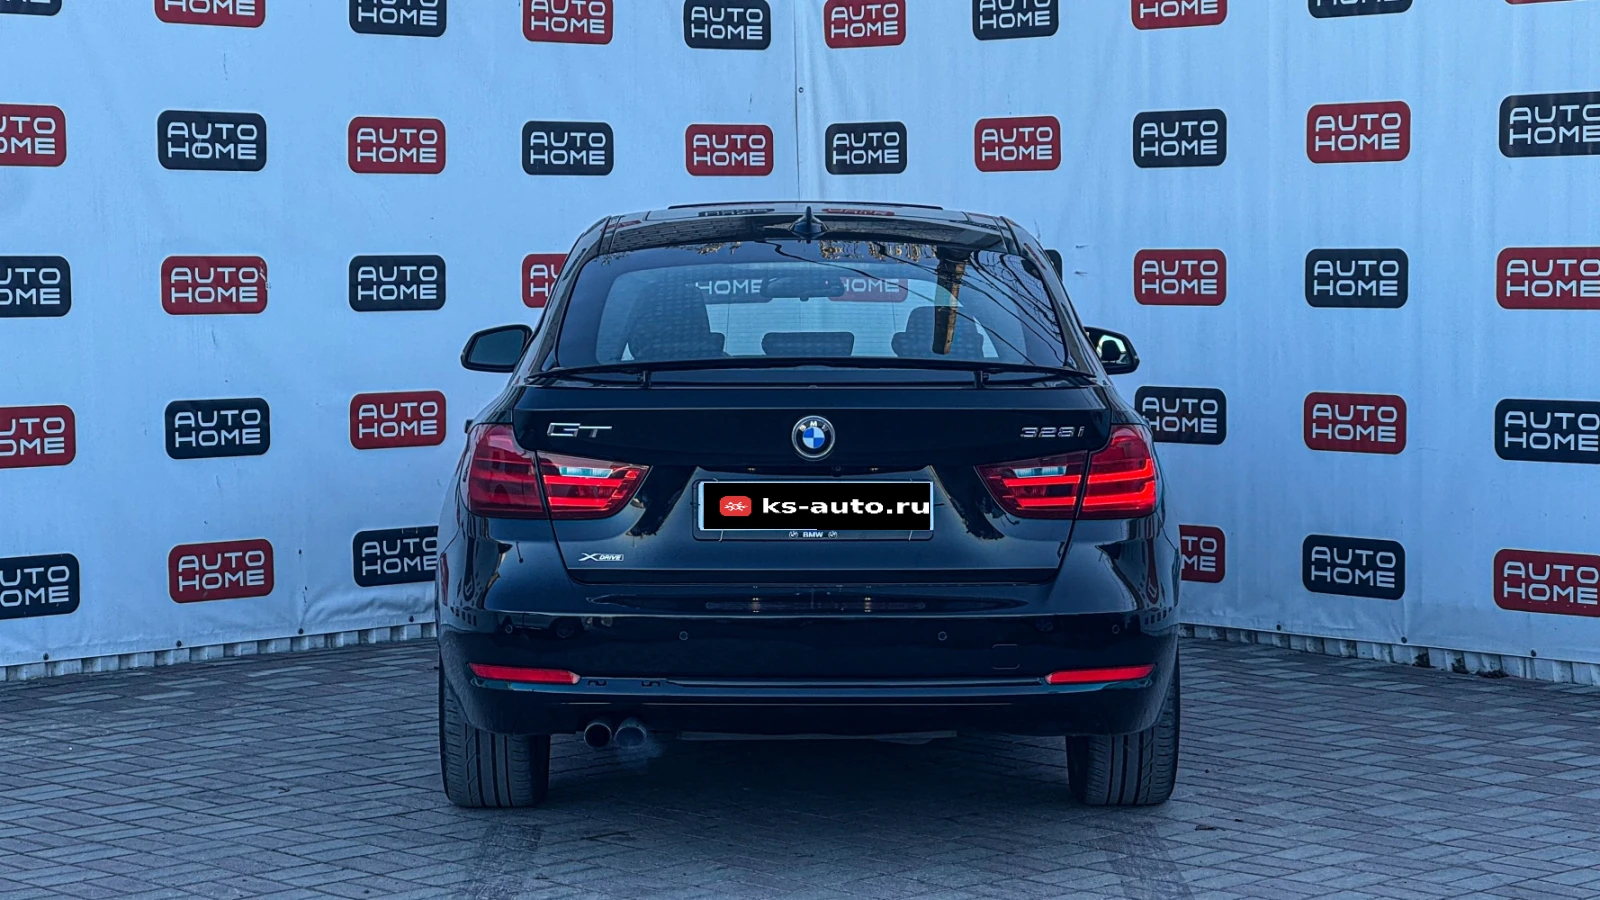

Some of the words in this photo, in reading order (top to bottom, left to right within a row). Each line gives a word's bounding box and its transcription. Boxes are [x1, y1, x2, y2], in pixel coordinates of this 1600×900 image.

[358, 7, 437, 25] HOME
[531, 0, 606, 16] AUTO
[692, 7, 763, 22] AUTO
[831, 3, 899, 21] AUTO
[1140, 0, 1217, 18] HOME
[531, 16, 604, 33] HOME
[980, 11, 1050, 29] HOME
[691, 24, 762, 39] HOME
[831, 21, 898, 38] HOME
[1316, 113, 1401, 131] AUTO
[1510, 104, 1600, 124] AUTO
[168, 122, 257, 140] AUTO
[357, 128, 437, 144] AUTO
[982, 127, 1052, 143] AUTO
[1141, 121, 1218, 138] AUTO
[1509, 125, 1600, 145] HOME
[531, 132, 605, 147] AUTO
[694, 135, 765, 148] AUTO
[833, 132, 899, 147] AUTO
[1141, 140, 1217, 156] HOME
[1316, 133, 1399, 151] HOME
[168, 142, 256, 159] HOME
[357, 147, 436, 162] HOME
[531, 150, 605, 164] HOME
[694, 152, 765, 165] HOME
[833, 149, 899, 164] HOME
[982, 145, 1052, 161] HOME
[171, 268, 258, 283] AUTO
[358, 266, 437, 281] AUTO
[1142, 261, 1218, 275] AUTO
[1315, 261, 1398, 276] AUTO
[1507, 260, 1600, 276] AUTO
[172, 287, 257, 303] HOME
[358, 284, 436, 300] HOME
[695, 280, 763, 295] HOME
[1142, 279, 1217, 294] HOME
[1314, 280, 1397, 296] HOME
[1507, 280, 1600, 297] HOME
[359, 402, 437, 419] AUTO
[1143, 398, 1217, 414] AUTO
[1313, 404, 1397, 422] AUTO
[175, 410, 260, 427] AUTO
[1143, 415, 1217, 434] HOME
[1505, 411, 1600, 430] AUTO
[359, 420, 436, 438] HOME
[546, 422, 612, 438] GT
[1020, 426, 1085, 438] 328i
[1313, 423, 1395, 442] HOME
[176, 429, 260, 447] HOME
[1505, 432, 1598, 451] HOME
[179, 551, 264, 572] AUTO
[362, 555, 436, 576] HOME
[1312, 547, 1395, 567] AUTO
[0, 566, 69, 586] UTO
[179, 570, 264, 591] HOME
[1312, 566, 1394, 587] HOME
[1503, 561, 1599, 584] AUTO
[0, 586, 68, 606] OME
[1504, 581, 1598, 605] HOME
